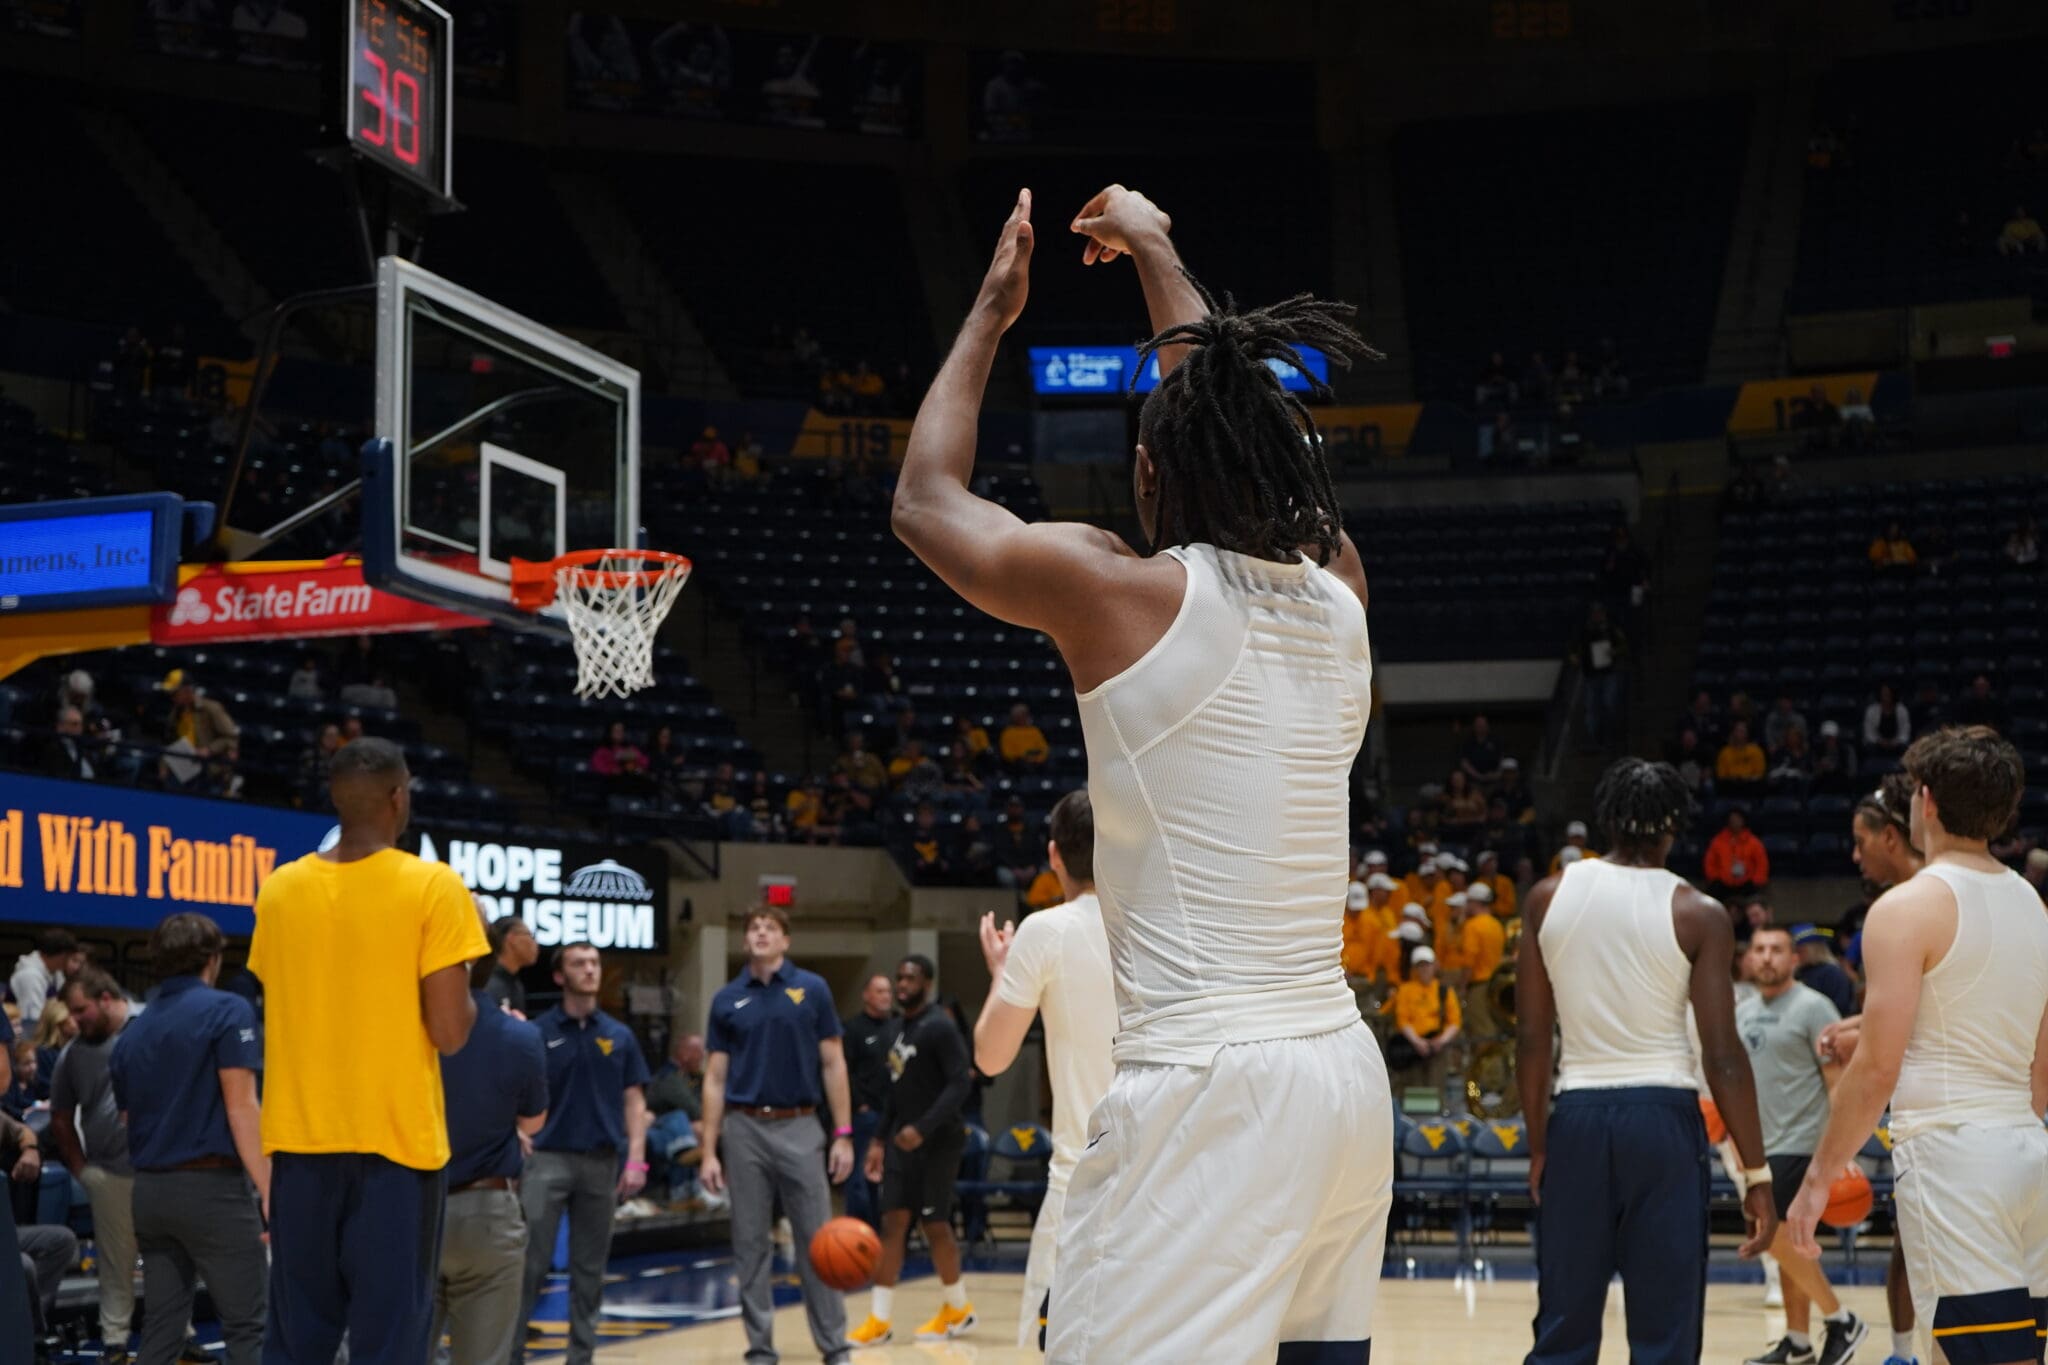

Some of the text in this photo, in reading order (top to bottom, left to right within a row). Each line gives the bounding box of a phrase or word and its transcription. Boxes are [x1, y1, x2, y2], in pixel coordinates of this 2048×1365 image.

[360, 49, 420, 166] 30
[95, 543, 146, 568] Inc.
[37, 813, 138, 897] With
[146, 825, 278, 913] Family
[448, 839, 563, 895] HOPE
